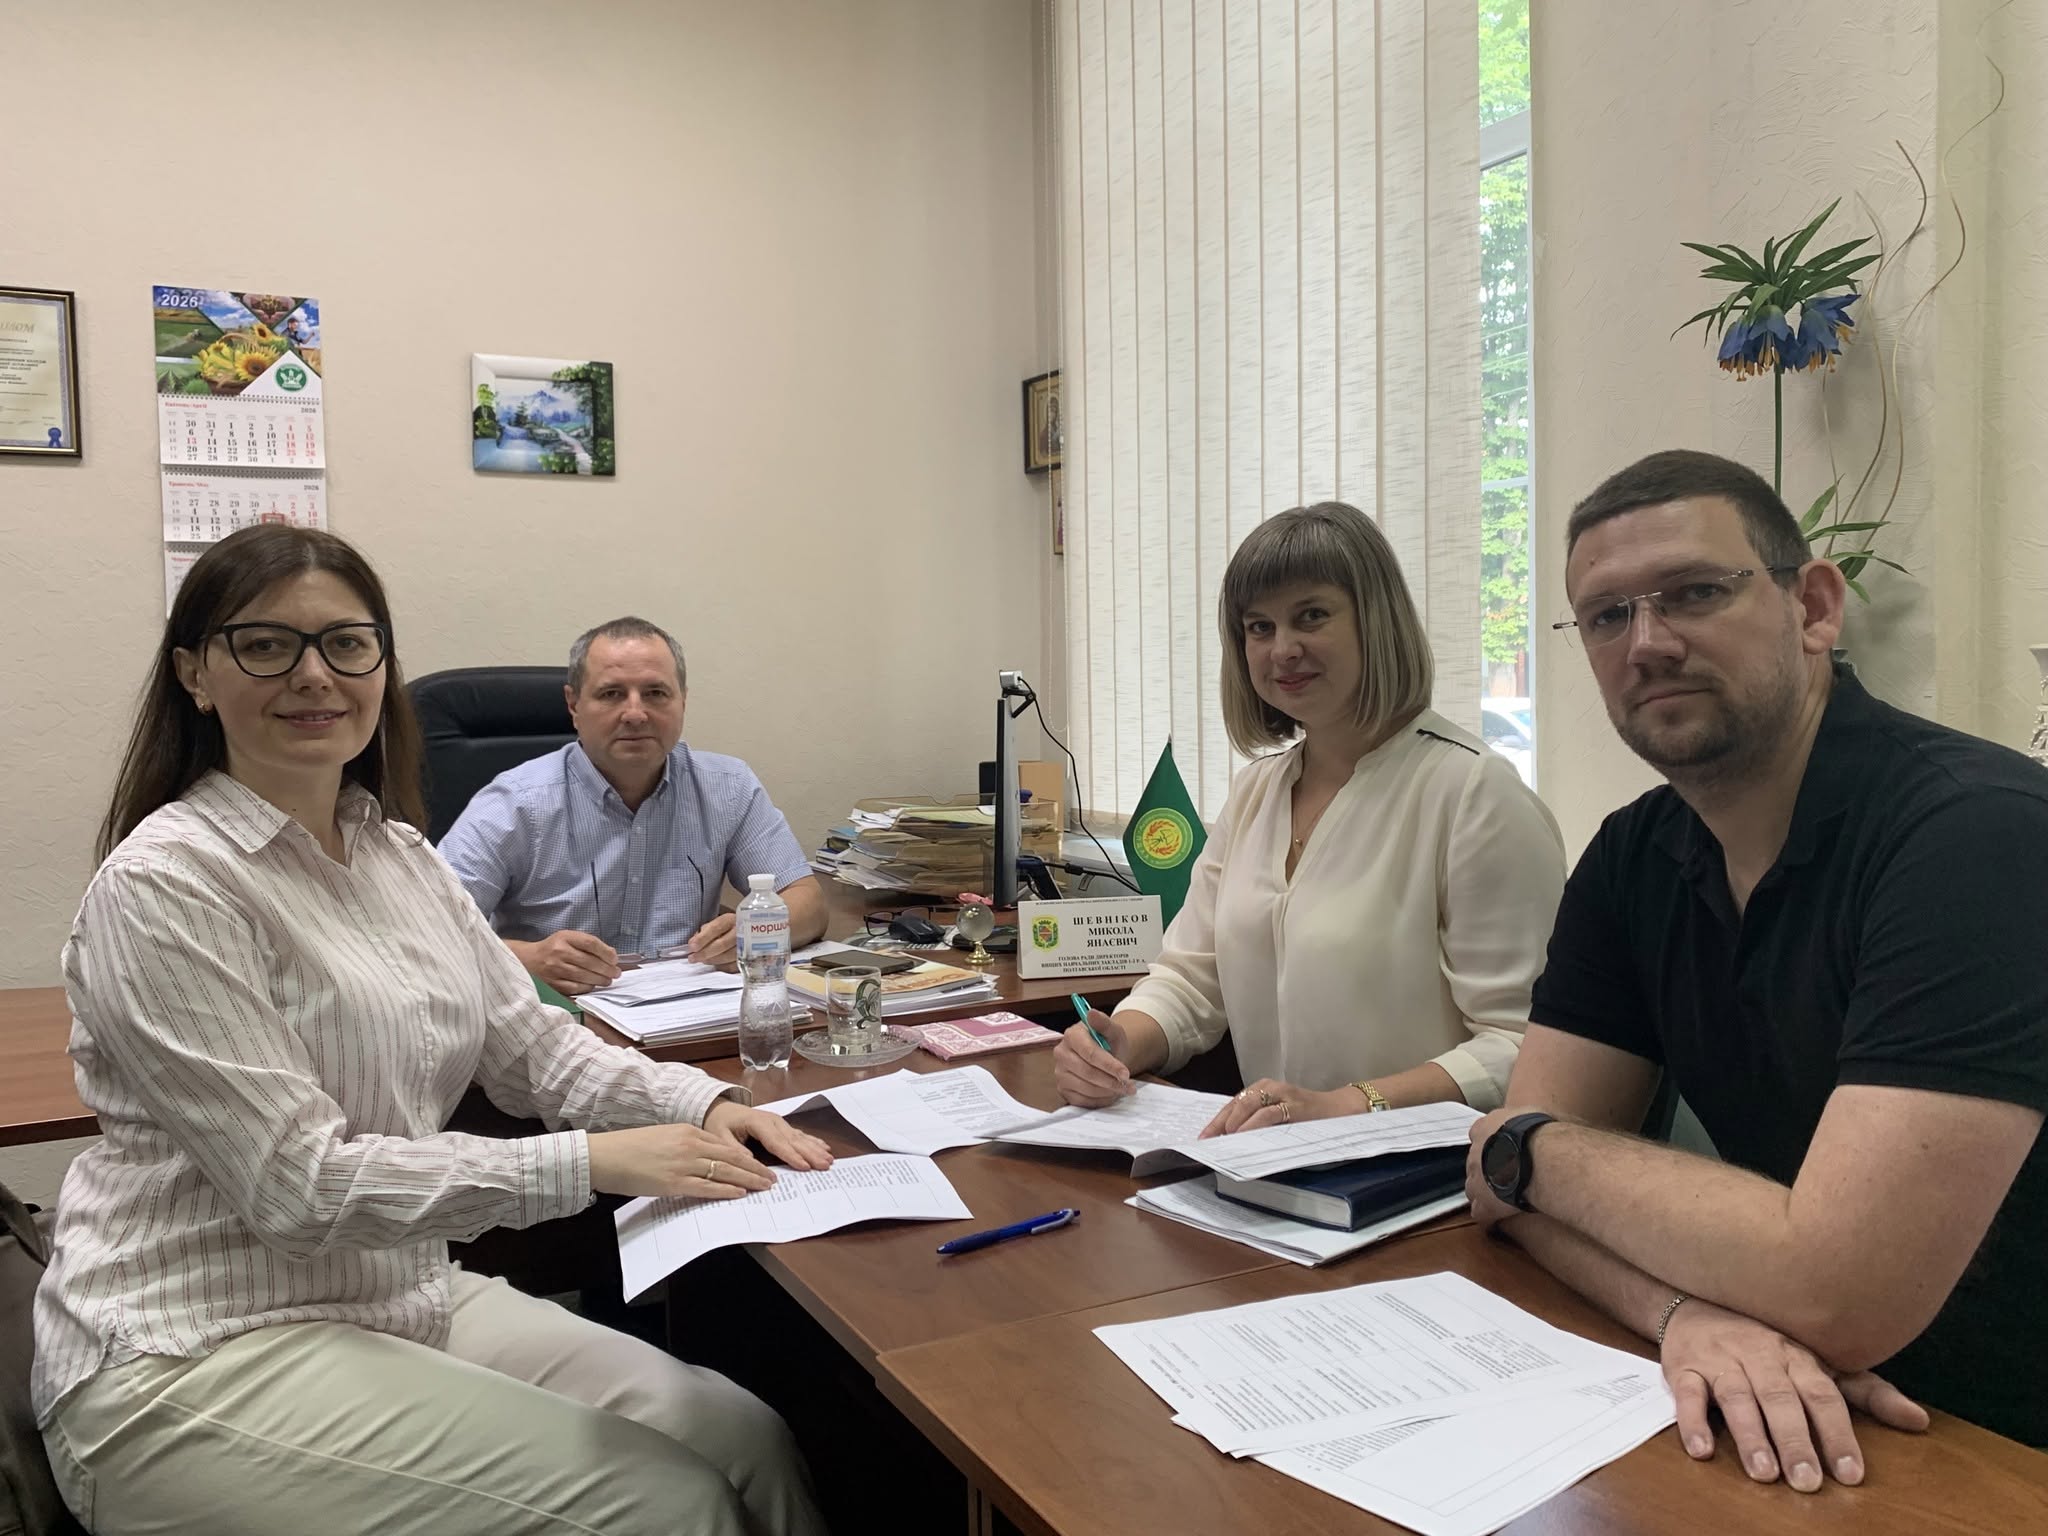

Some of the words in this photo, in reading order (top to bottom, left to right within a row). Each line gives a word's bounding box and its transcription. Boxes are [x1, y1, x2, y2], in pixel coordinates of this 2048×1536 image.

[161, 294, 198, 308] 2026
[185, 420, 197, 428] 30
[206, 420, 216, 428] 31
[208, 429, 214, 437] 7
[305, 432, 315, 441] 12
[251, 509, 257, 517] 7
[1073, 914, 1149, 925] ШЕВНІКОВ
[1088, 926, 1134, 936] МИКОЛА
